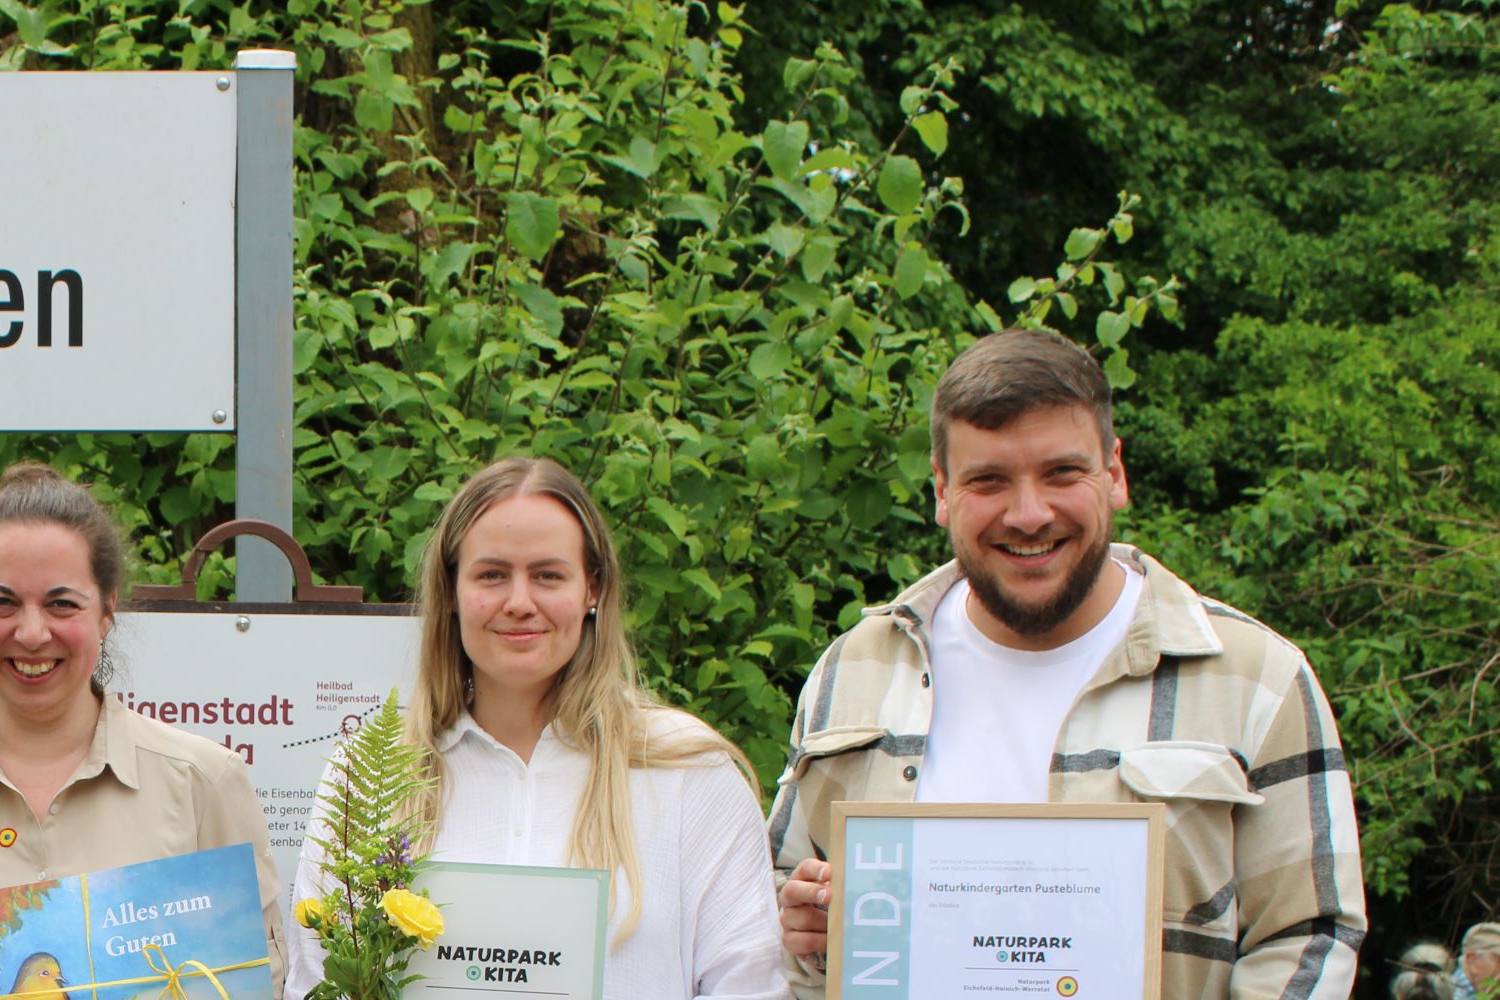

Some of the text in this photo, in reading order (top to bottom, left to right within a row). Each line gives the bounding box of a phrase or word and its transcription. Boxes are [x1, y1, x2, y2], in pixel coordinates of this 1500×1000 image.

[316, 681, 353, 691] Heilbad
[316, 693, 380, 705] Heiligenstadt
[929, 883, 1100, 895] Naturkindergarten Pusteblume
[102, 895, 212, 928] Alles zum
[105, 931, 177, 957] Guten
[973, 936, 1072, 948] NATURPARK
[437, 946, 562, 966] NATURPARK
[1011, 951, 1046, 962] KITA
[484, 966, 528, 983] KITA
